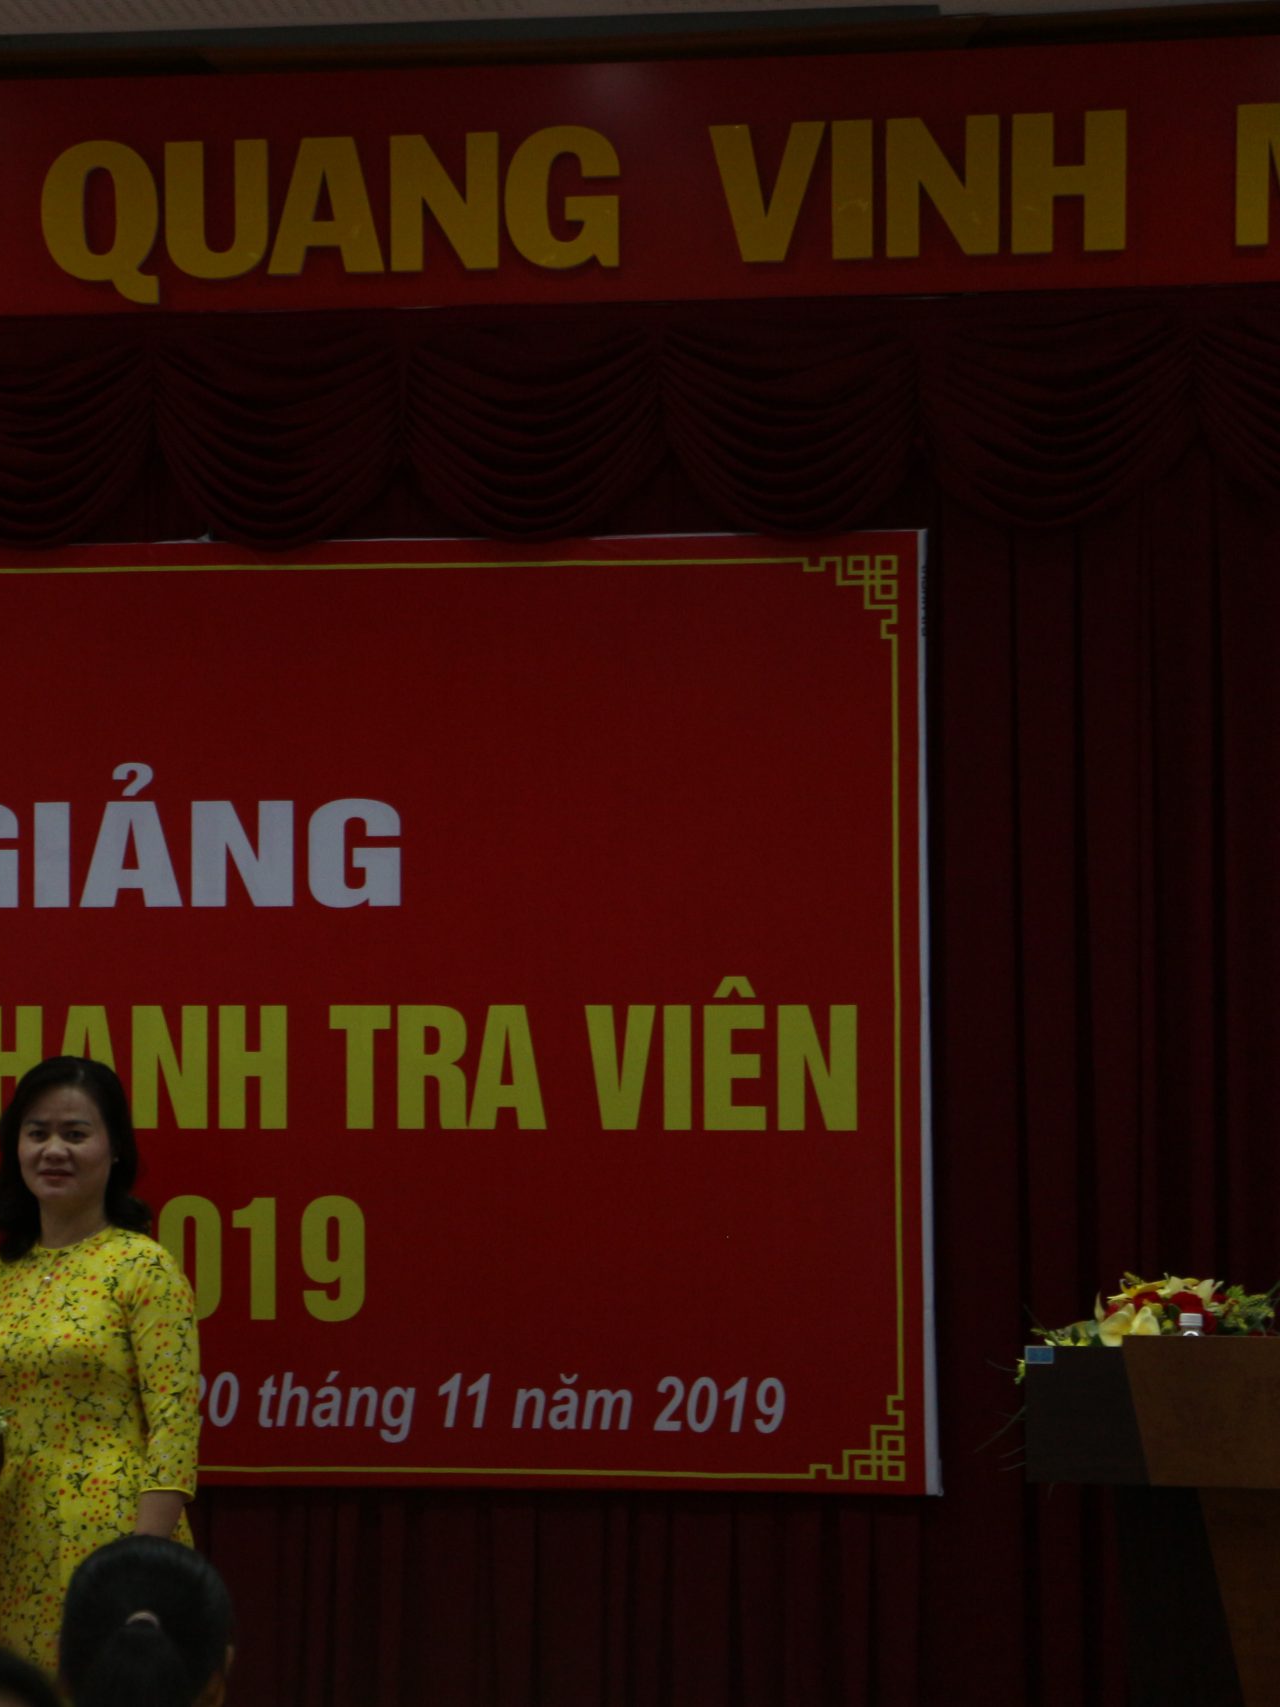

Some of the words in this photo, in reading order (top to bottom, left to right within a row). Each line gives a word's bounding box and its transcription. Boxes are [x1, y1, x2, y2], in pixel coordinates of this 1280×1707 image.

[41, 126, 620, 303] QUANG
[709, 110, 1127, 263] VINH
[329, 1004, 547, 1130] TRA
[585, 976, 858, 1131] VIÊN
[158, 1195, 366, 1321] 019
[258, 1370, 416, 1443] tháng
[438, 1372, 491, 1428] 11
[512, 1373, 633, 1430] năm
[653, 1375, 785, 1434] 2019
